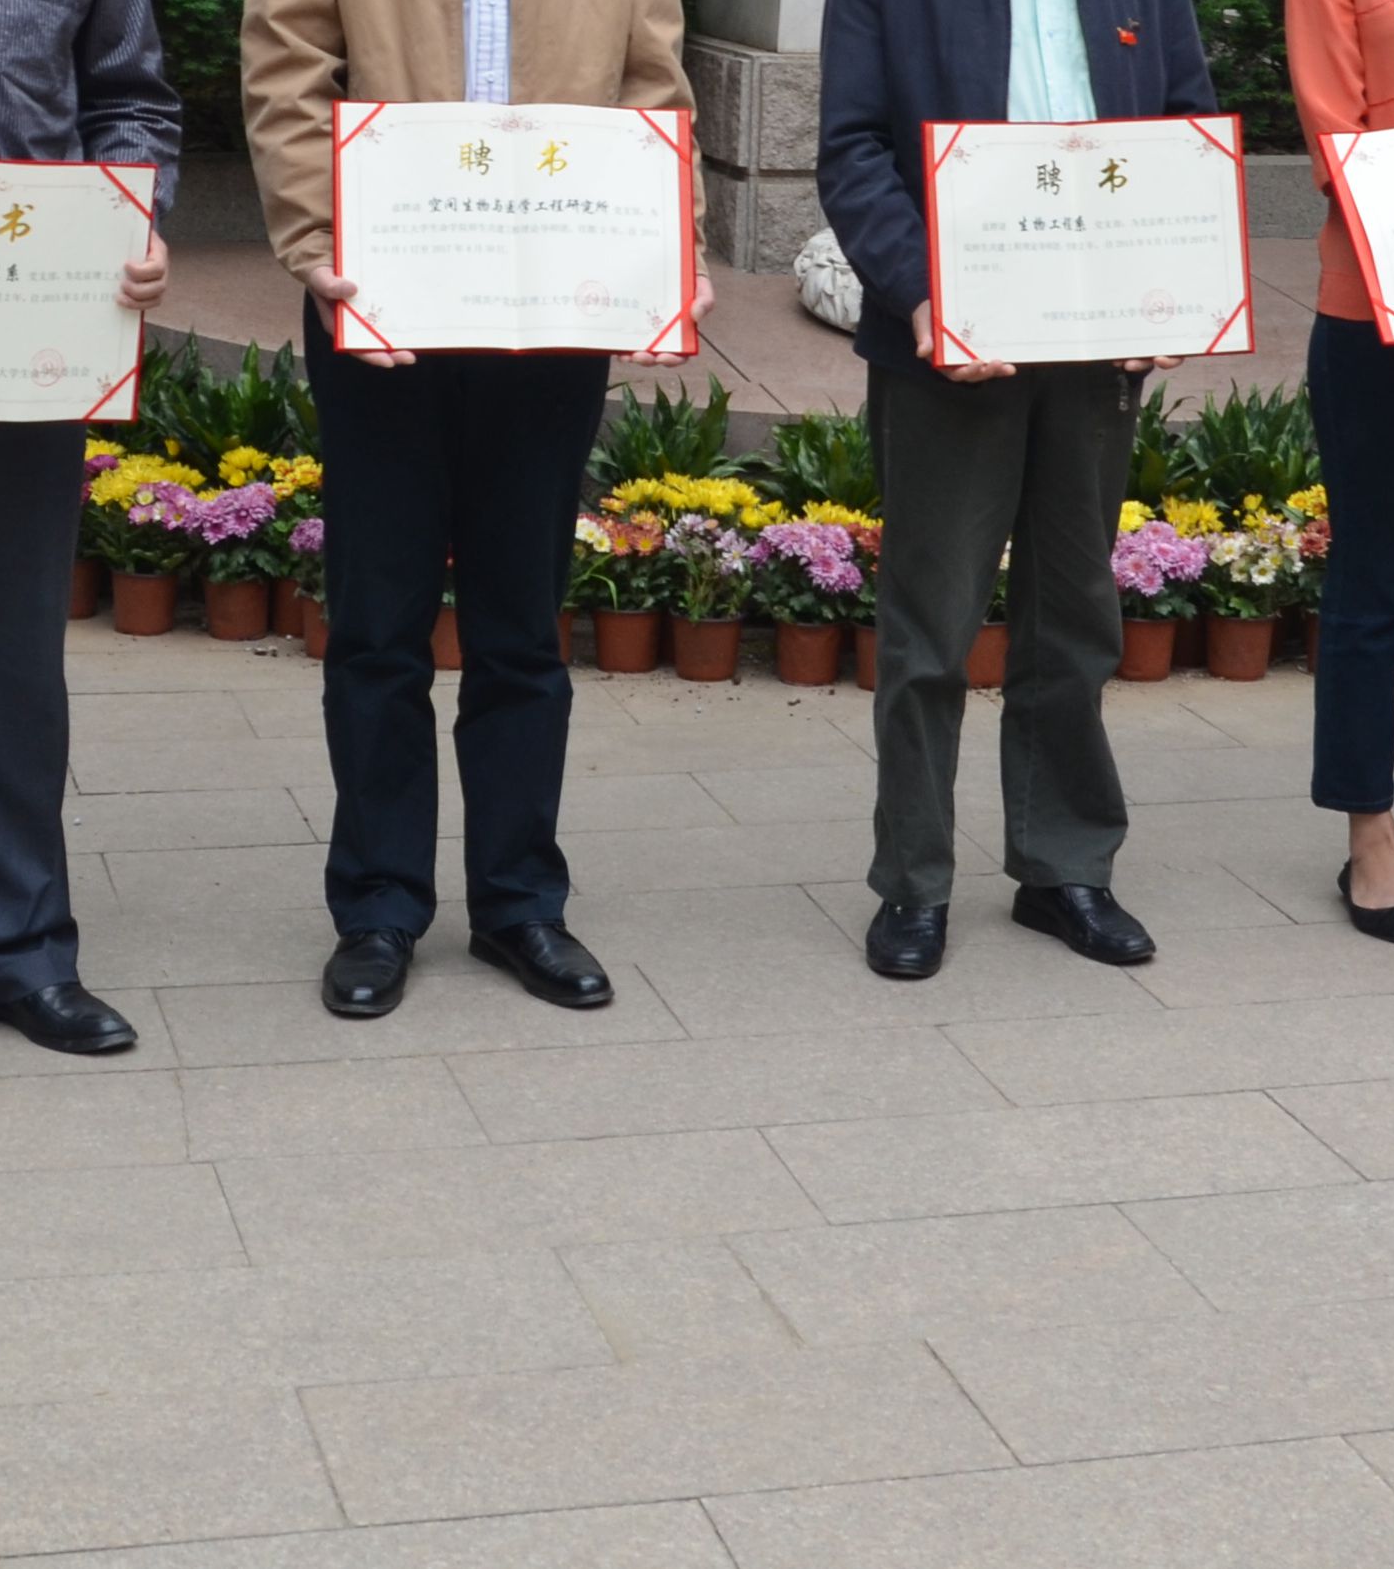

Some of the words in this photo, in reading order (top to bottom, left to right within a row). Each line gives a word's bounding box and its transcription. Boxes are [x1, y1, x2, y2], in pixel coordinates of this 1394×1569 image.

[428, 197, 610, 215] 空间生物与医学工程研究所
[1018, 215, 1087, 232] 生物工程系
